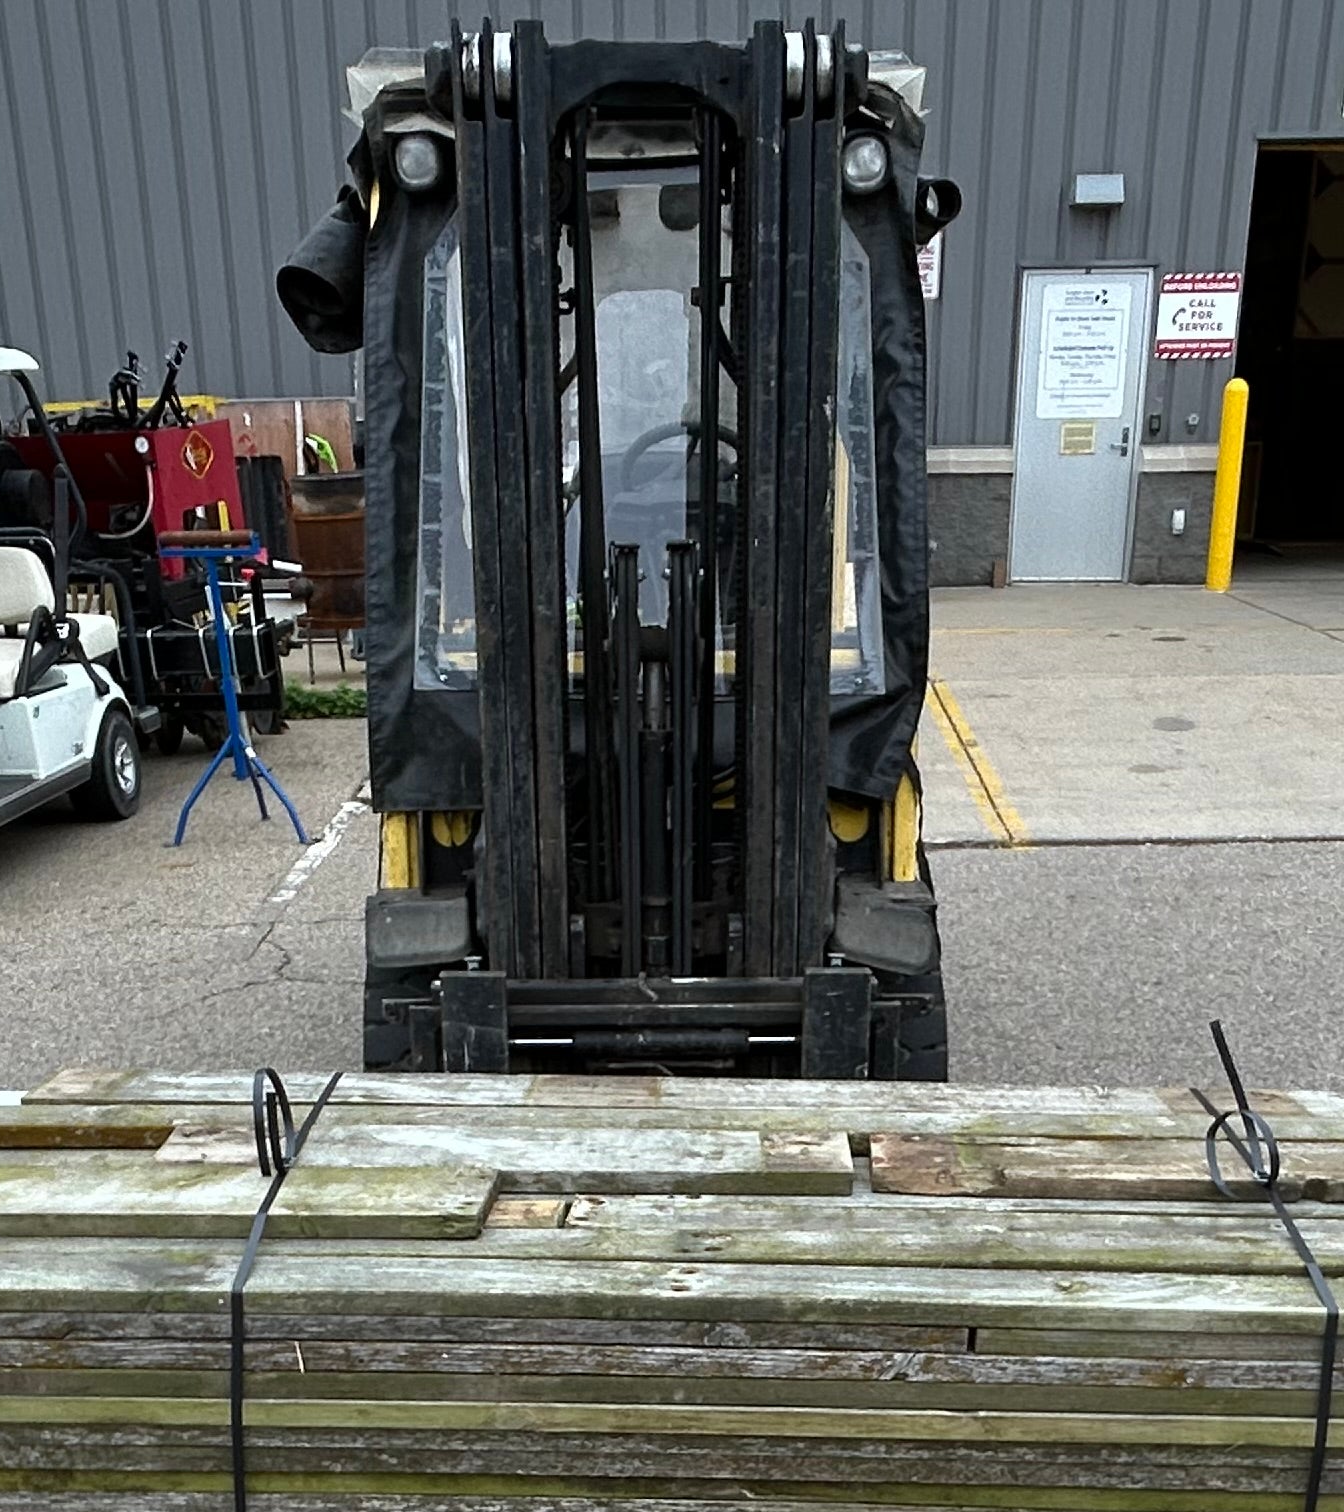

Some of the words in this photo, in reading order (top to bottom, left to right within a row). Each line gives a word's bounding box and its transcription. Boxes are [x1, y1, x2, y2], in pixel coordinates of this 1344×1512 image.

[1189, 299, 1216, 307] CALL
[1191, 311, 1213, 319] FOR
[1178, 323, 1223, 331] SERVICE
